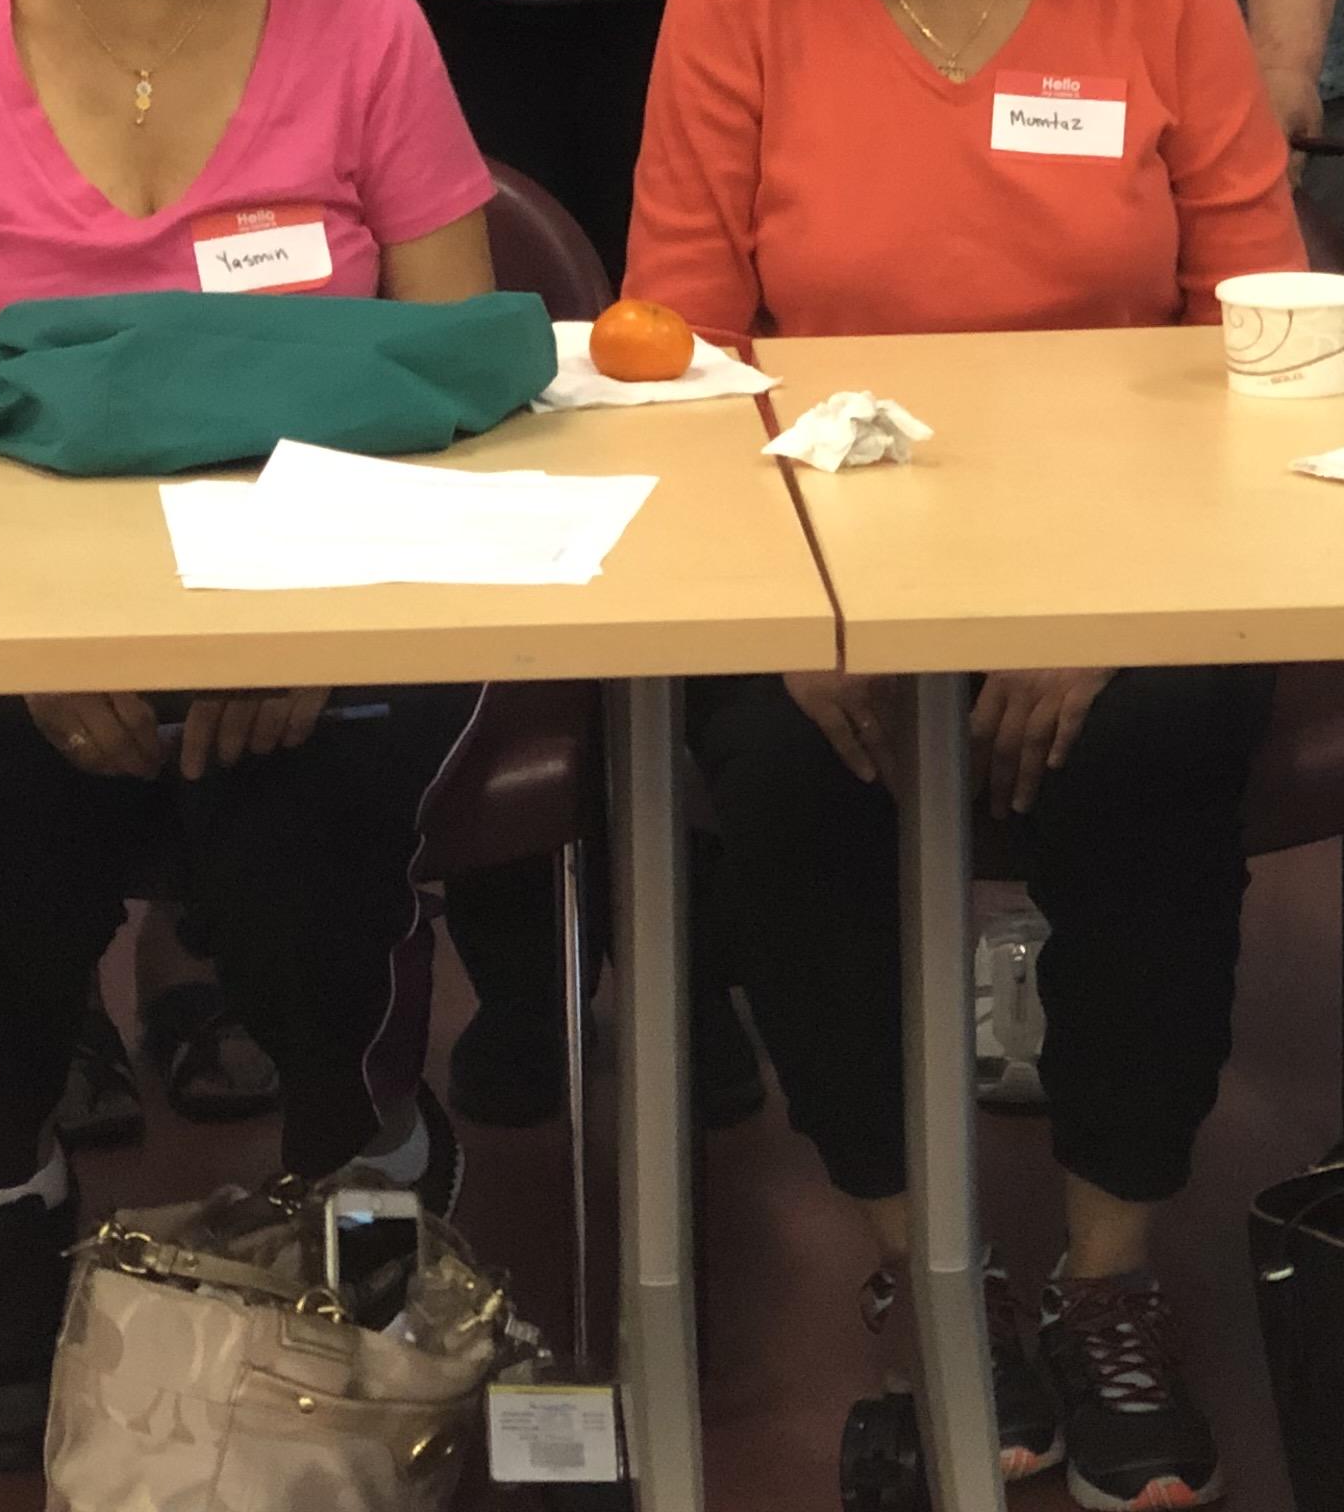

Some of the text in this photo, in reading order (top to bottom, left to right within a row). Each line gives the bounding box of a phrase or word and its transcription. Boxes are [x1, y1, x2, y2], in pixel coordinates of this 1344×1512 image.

[1042, 76, 1081, 92] Hello
[1009, 109, 1084, 131] Mumtaz
[236, 209, 276, 226] Hello
[215, 247, 289, 273] Yasmin
